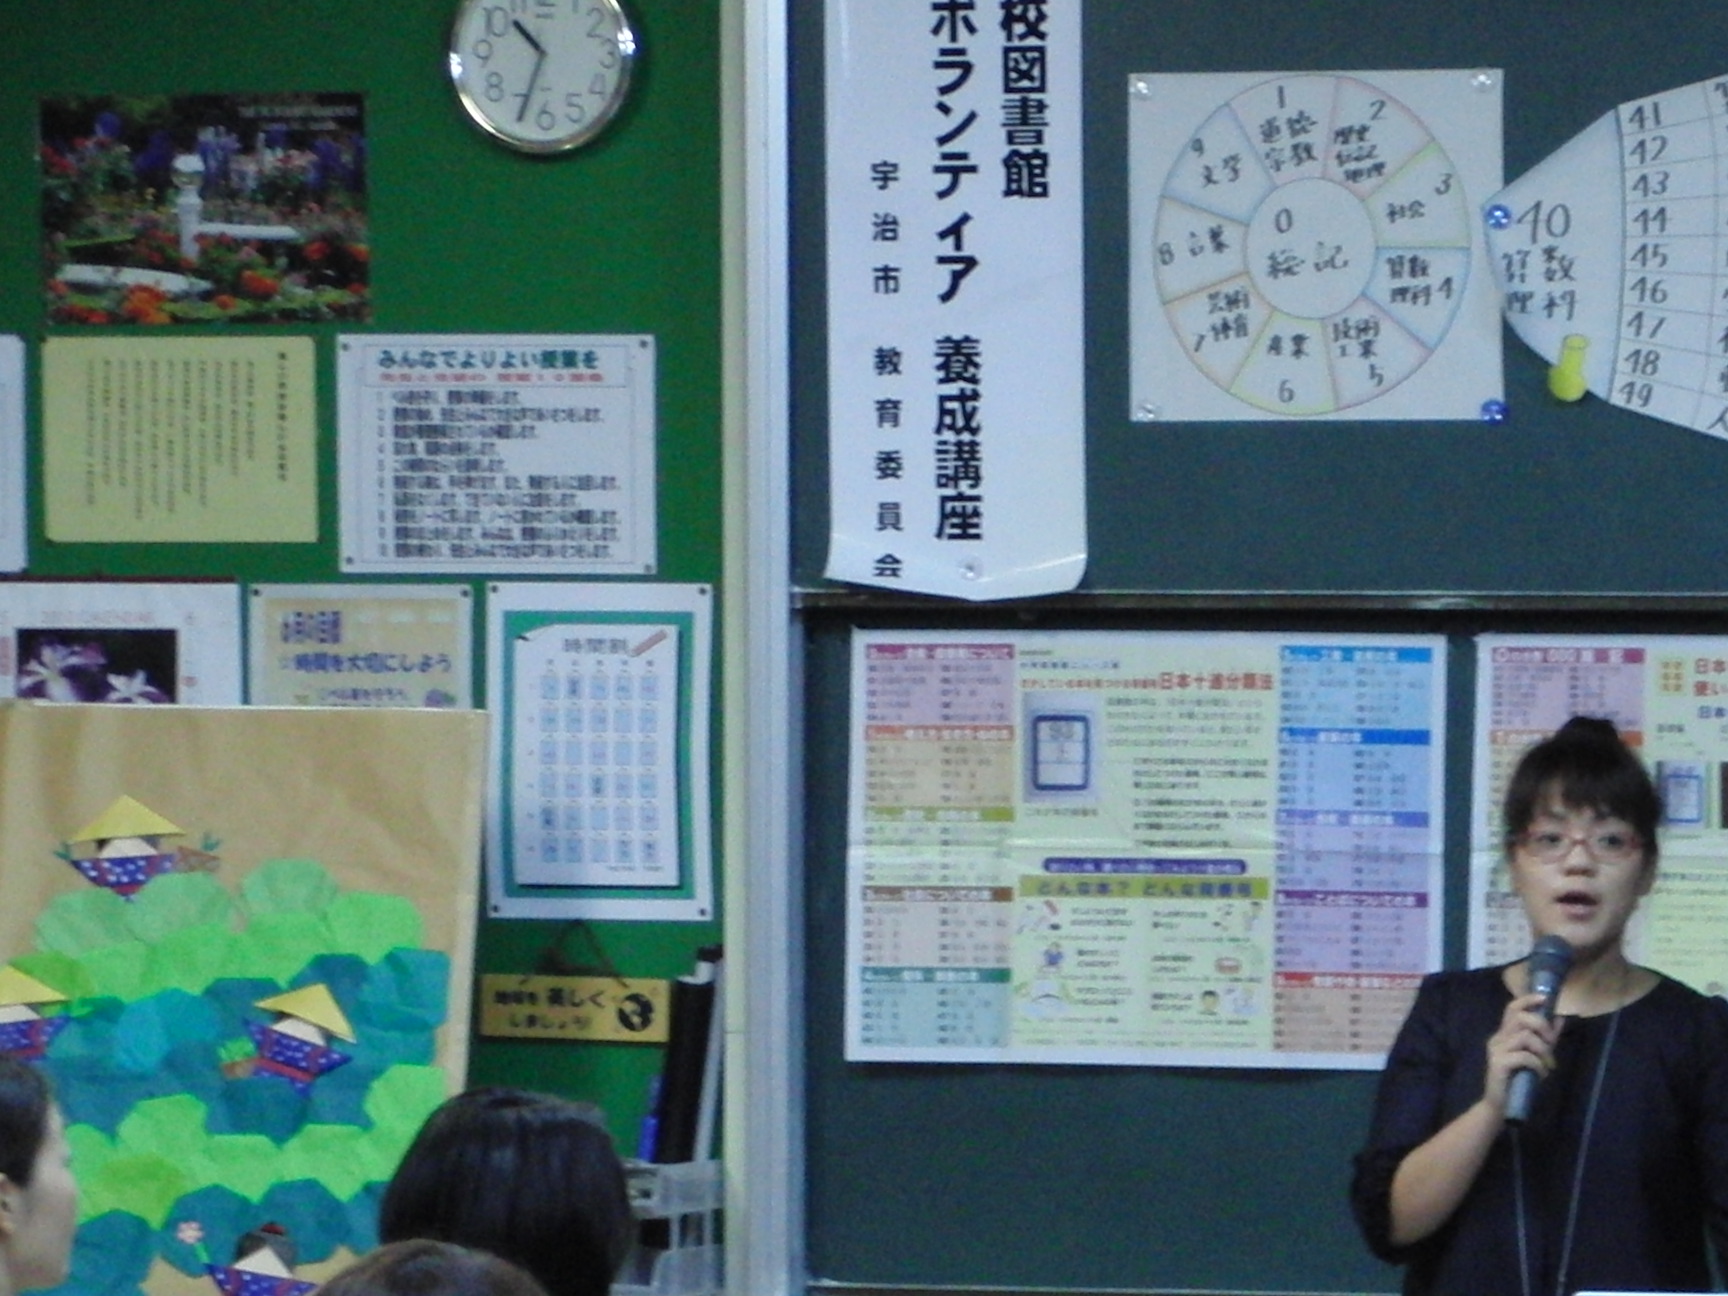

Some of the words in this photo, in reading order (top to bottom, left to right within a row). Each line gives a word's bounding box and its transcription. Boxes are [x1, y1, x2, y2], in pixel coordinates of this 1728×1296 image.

[484, 6, 509, 38] 10
[586, 7, 605, 38] 2
[472, 39, 492, 68] 9
[599, 38, 617, 69] 3
[484, 71, 504, 102] 8
[588, 73, 607, 98] 4
[999, 0, 1049, 199] 校図書館
[1276, 84, 1287, 109] 1
[535, 101, 556, 131] 6
[564, 92, 586, 123] 5
[1369, 98, 1387, 121] 2
[1628, 104, 1663, 130] 41
[1190, 137, 1205, 159] 9
[1629, 136, 1668, 164] 42
[1201, 153, 1242, 189] 文学
[1434, 172, 1454, 196] 3
[1631, 171, 1670, 197] 43
[1274, 208, 1293, 234] 0
[1386, 199, 1426, 225] 社会
[1517, 200, 1572, 244] 40
[1632, 206, 1669, 234] 44
[870, 160, 902, 295] 宇治市
[1158, 242, 1175, 266] 8
[1501, 246, 1576, 284] 算数
[1630, 243, 1669, 269] 45
[1437, 276, 1454, 300] 4
[1629, 277, 1669, 304] 46
[1505, 290, 1576, 321] 理科
[1627, 310, 1665, 339] 47
[1368, 363, 1384, 388] 5
[1624, 349, 1661, 376] 48
[1278, 379, 1296, 404] 6
[1619, 379, 1654, 407] 49
[934, 337, 984, 542] 養成講座
[873, 346, 904, 578] 教育委員会
